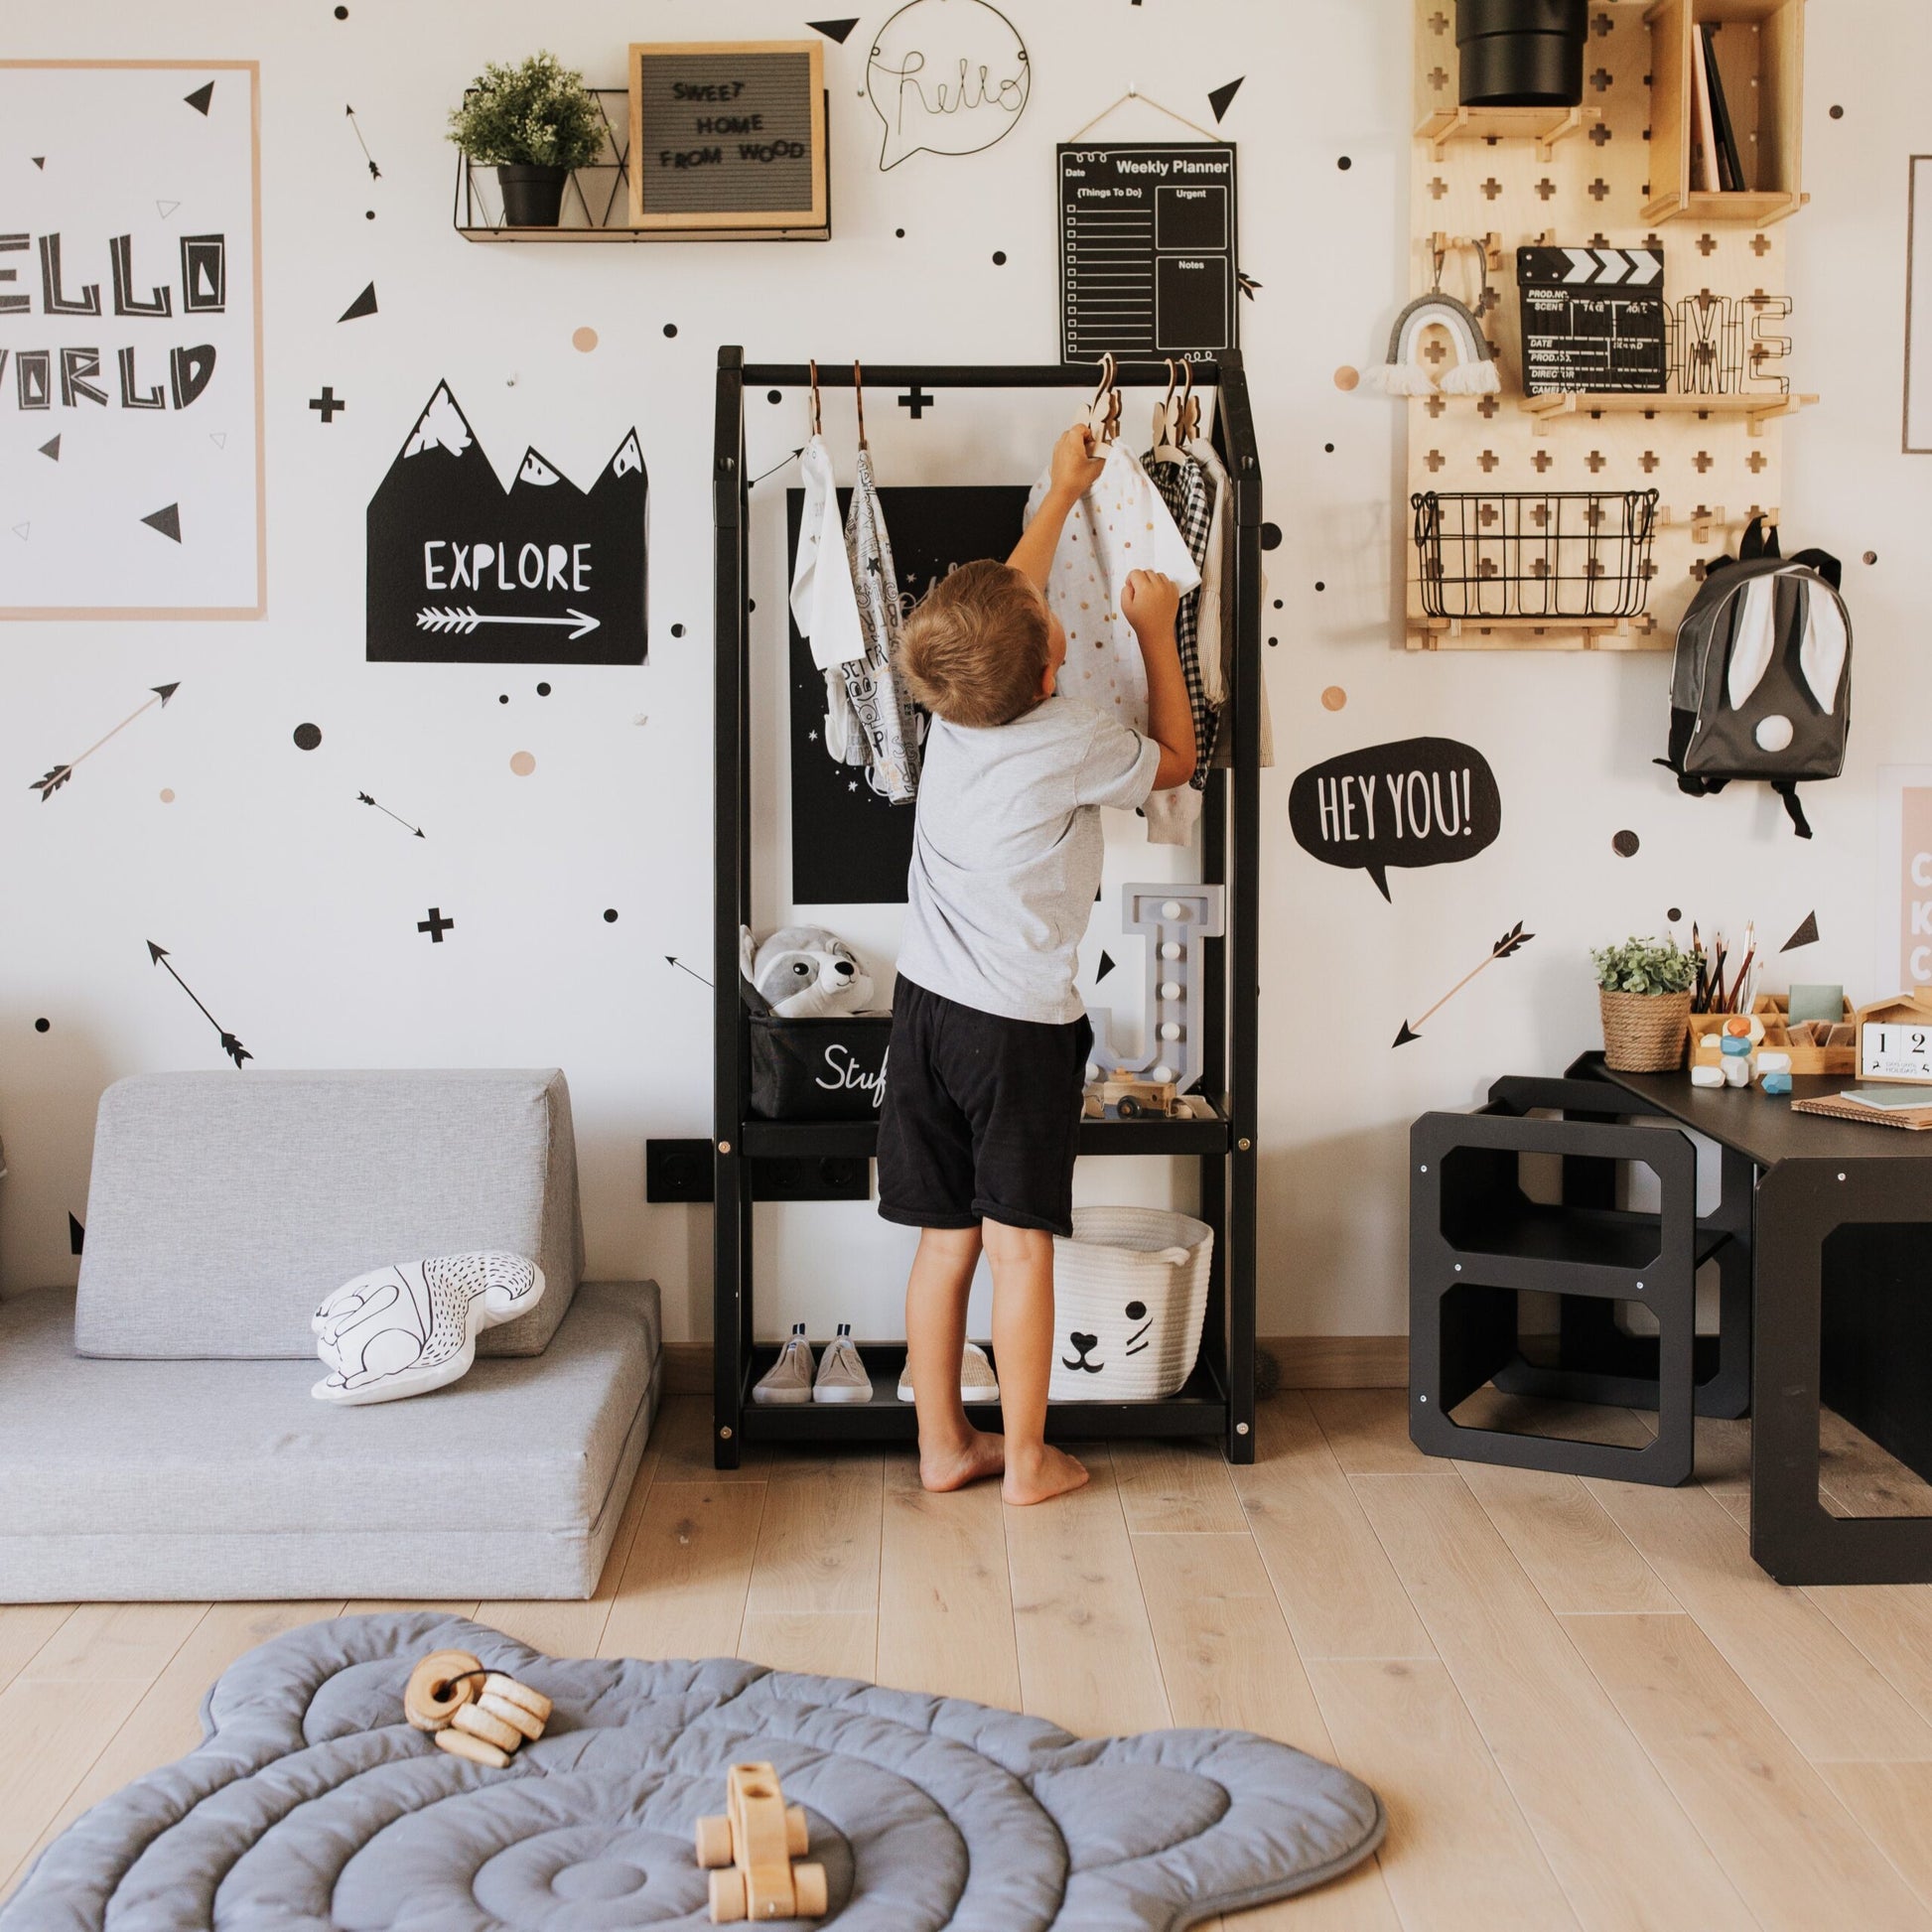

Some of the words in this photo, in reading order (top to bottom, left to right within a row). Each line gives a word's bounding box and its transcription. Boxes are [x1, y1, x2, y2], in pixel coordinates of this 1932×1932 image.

[672, 81, 745, 102] SWEET
[697, 114, 764, 135] HOME
[659, 147, 723, 170] FROM
[738, 139, 805, 163] WOOD
[1065, 168, 1086, 178] Date
[1116, 160, 1169, 177] Weekly
[1173, 160, 1230, 174] Planner
[1113, 188, 1125, 197] To
[1175, 190, 1206, 200] Urgent
[1178, 260, 1204, 270] Notes
[1534, 302, 1565, 312] SCENE
[1530, 339, 1554, 348] DATE
[0, 345, 216, 411] ORLD
[424, 540, 593, 592] EXPLORE
[1317, 774, 1376, 842] HEY
[1386, 767, 1470, 839] YOU!
